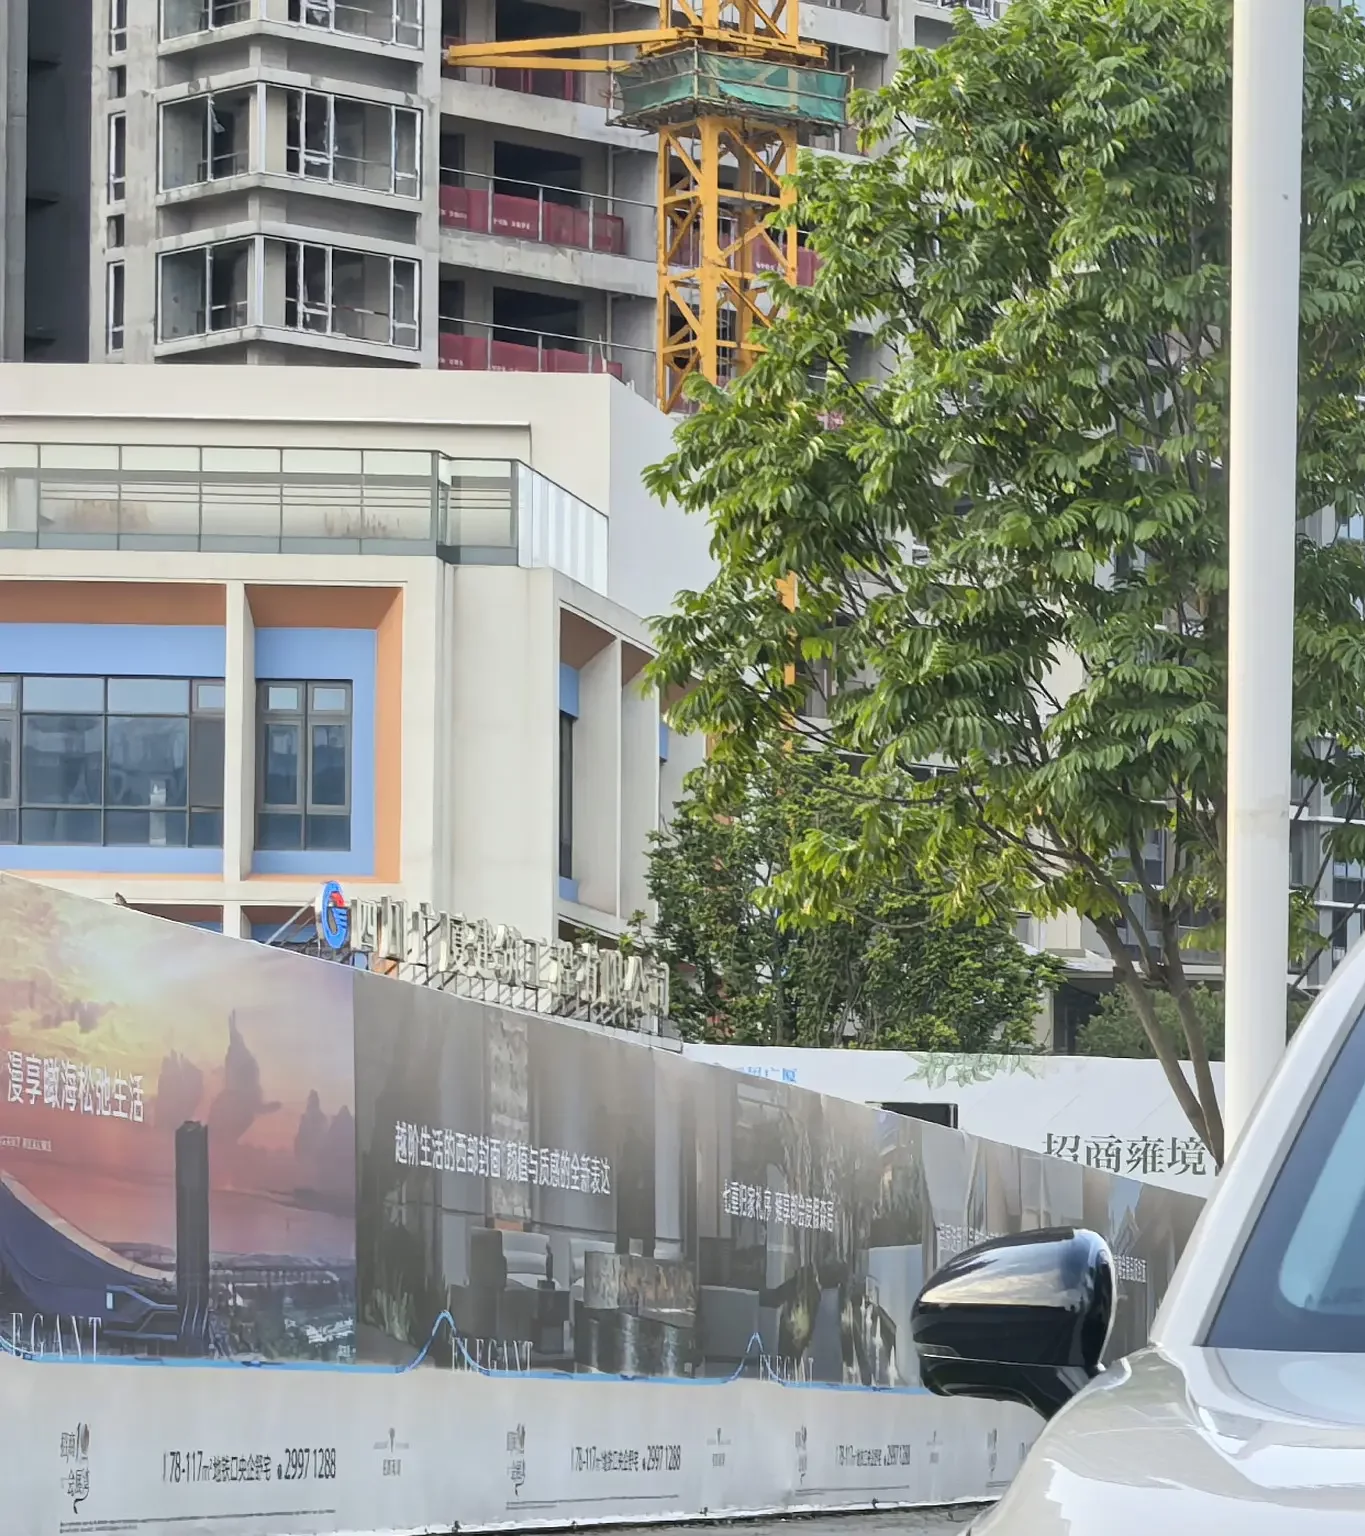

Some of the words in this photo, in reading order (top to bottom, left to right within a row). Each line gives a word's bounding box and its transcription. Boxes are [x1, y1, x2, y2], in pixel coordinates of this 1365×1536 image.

[8, 1051, 144, 1122] 漫享瞰海松弛生活
[1041, 1133, 1220, 1176] 招商雍境
